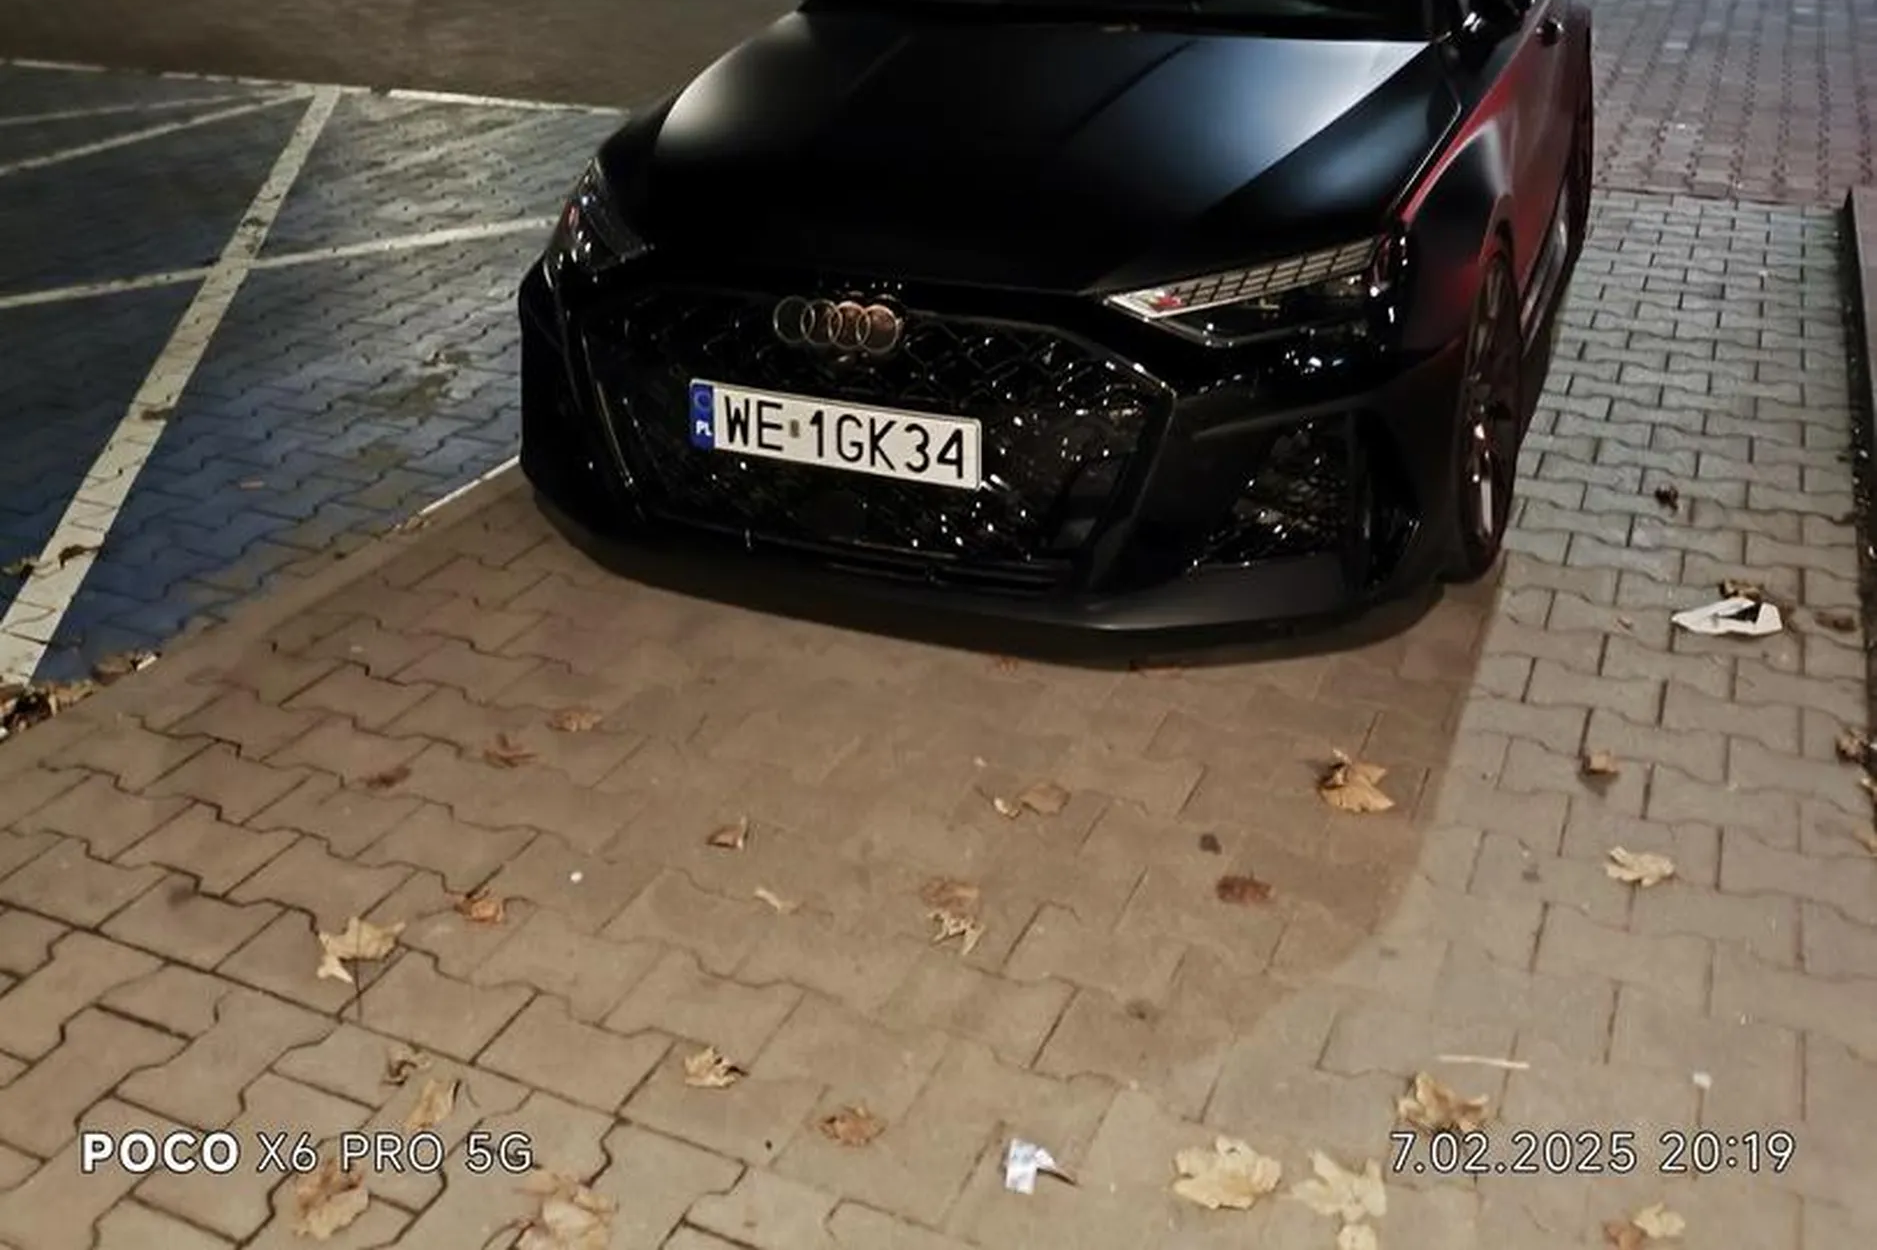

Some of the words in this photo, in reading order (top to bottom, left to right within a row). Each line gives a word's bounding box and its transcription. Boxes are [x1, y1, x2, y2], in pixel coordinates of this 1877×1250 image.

[695, 419, 713, 437] PL
[725, 395, 784, 451] WE
[809, 409, 964, 480] 1GK34
